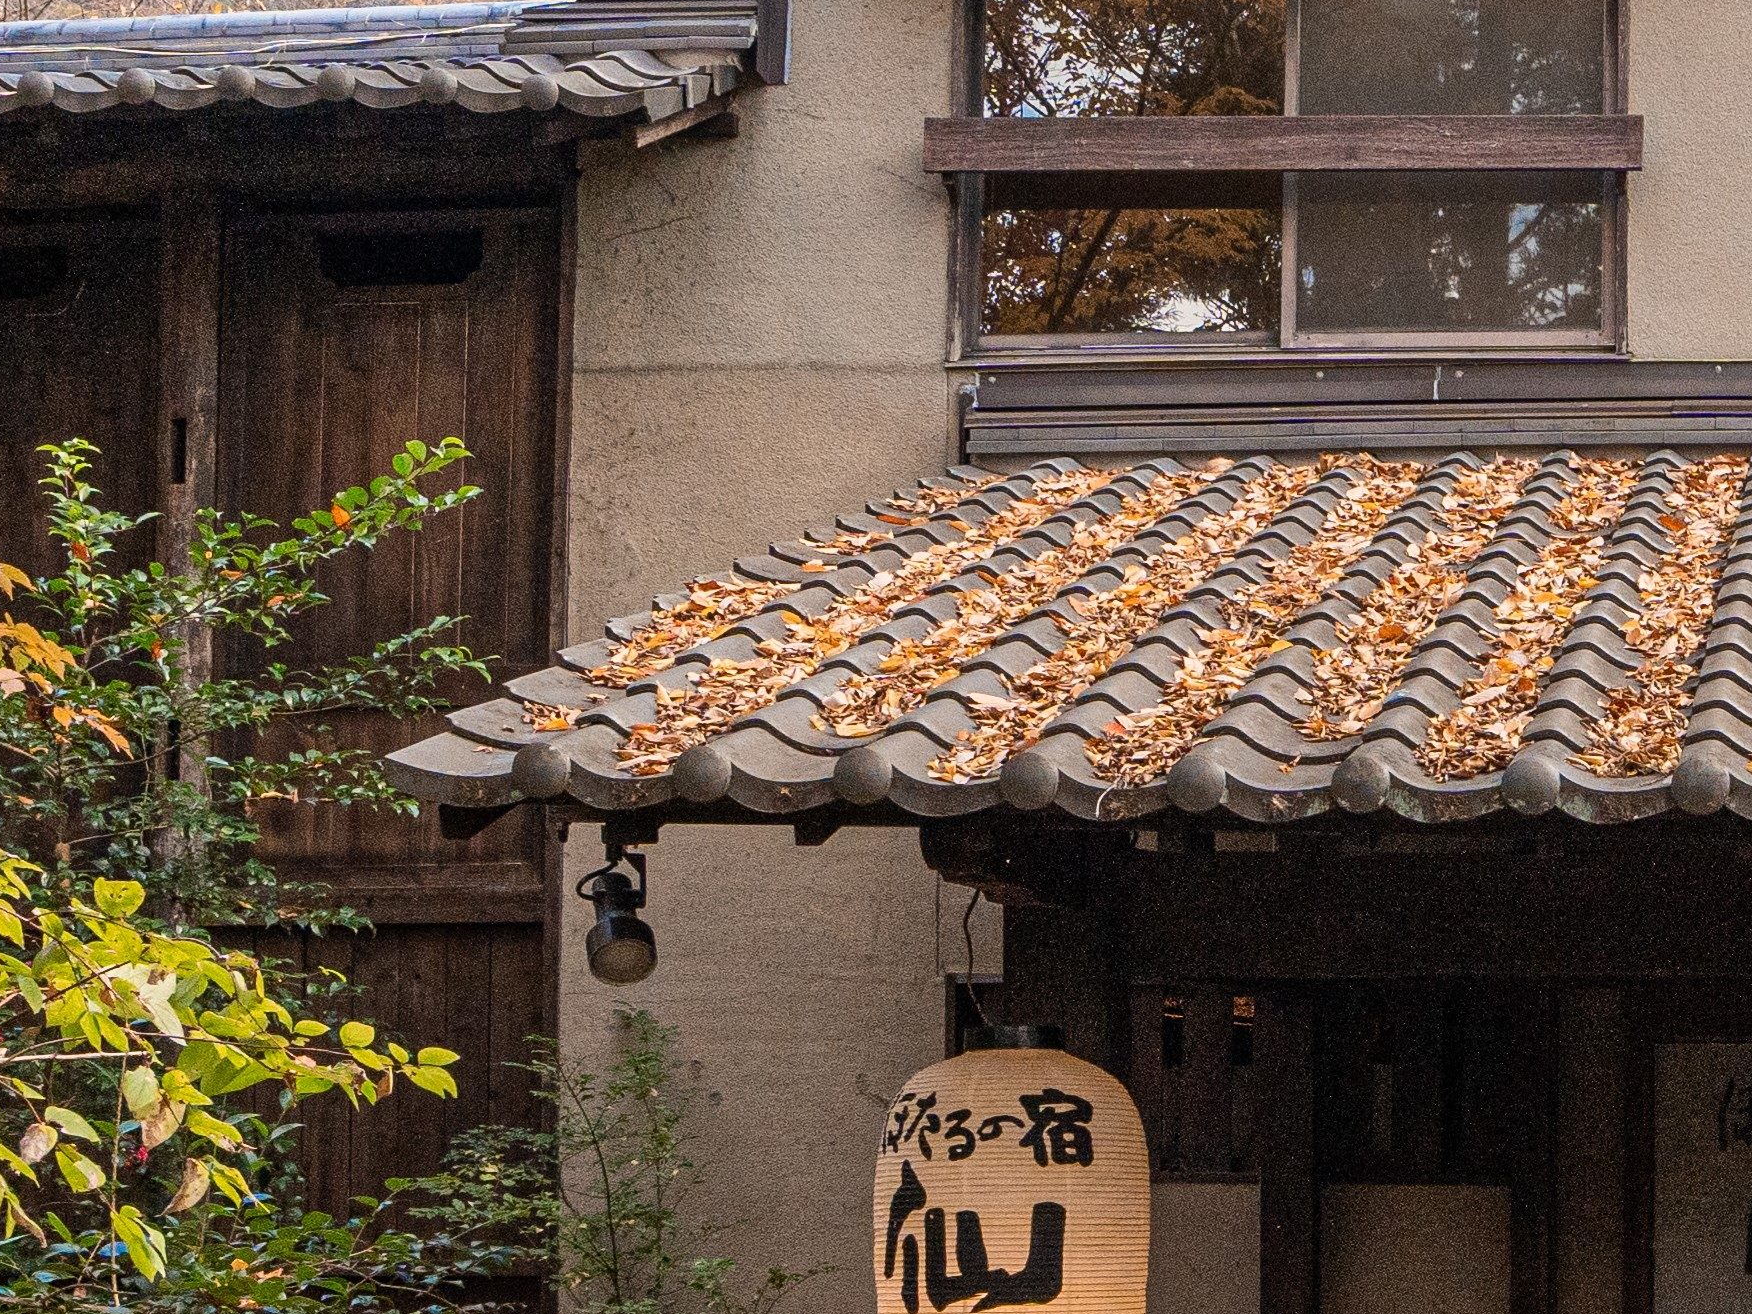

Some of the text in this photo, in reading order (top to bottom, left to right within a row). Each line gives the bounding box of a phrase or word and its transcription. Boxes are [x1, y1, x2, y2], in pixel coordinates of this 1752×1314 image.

[882, 1089, 1094, 1166] ほたるの宿
